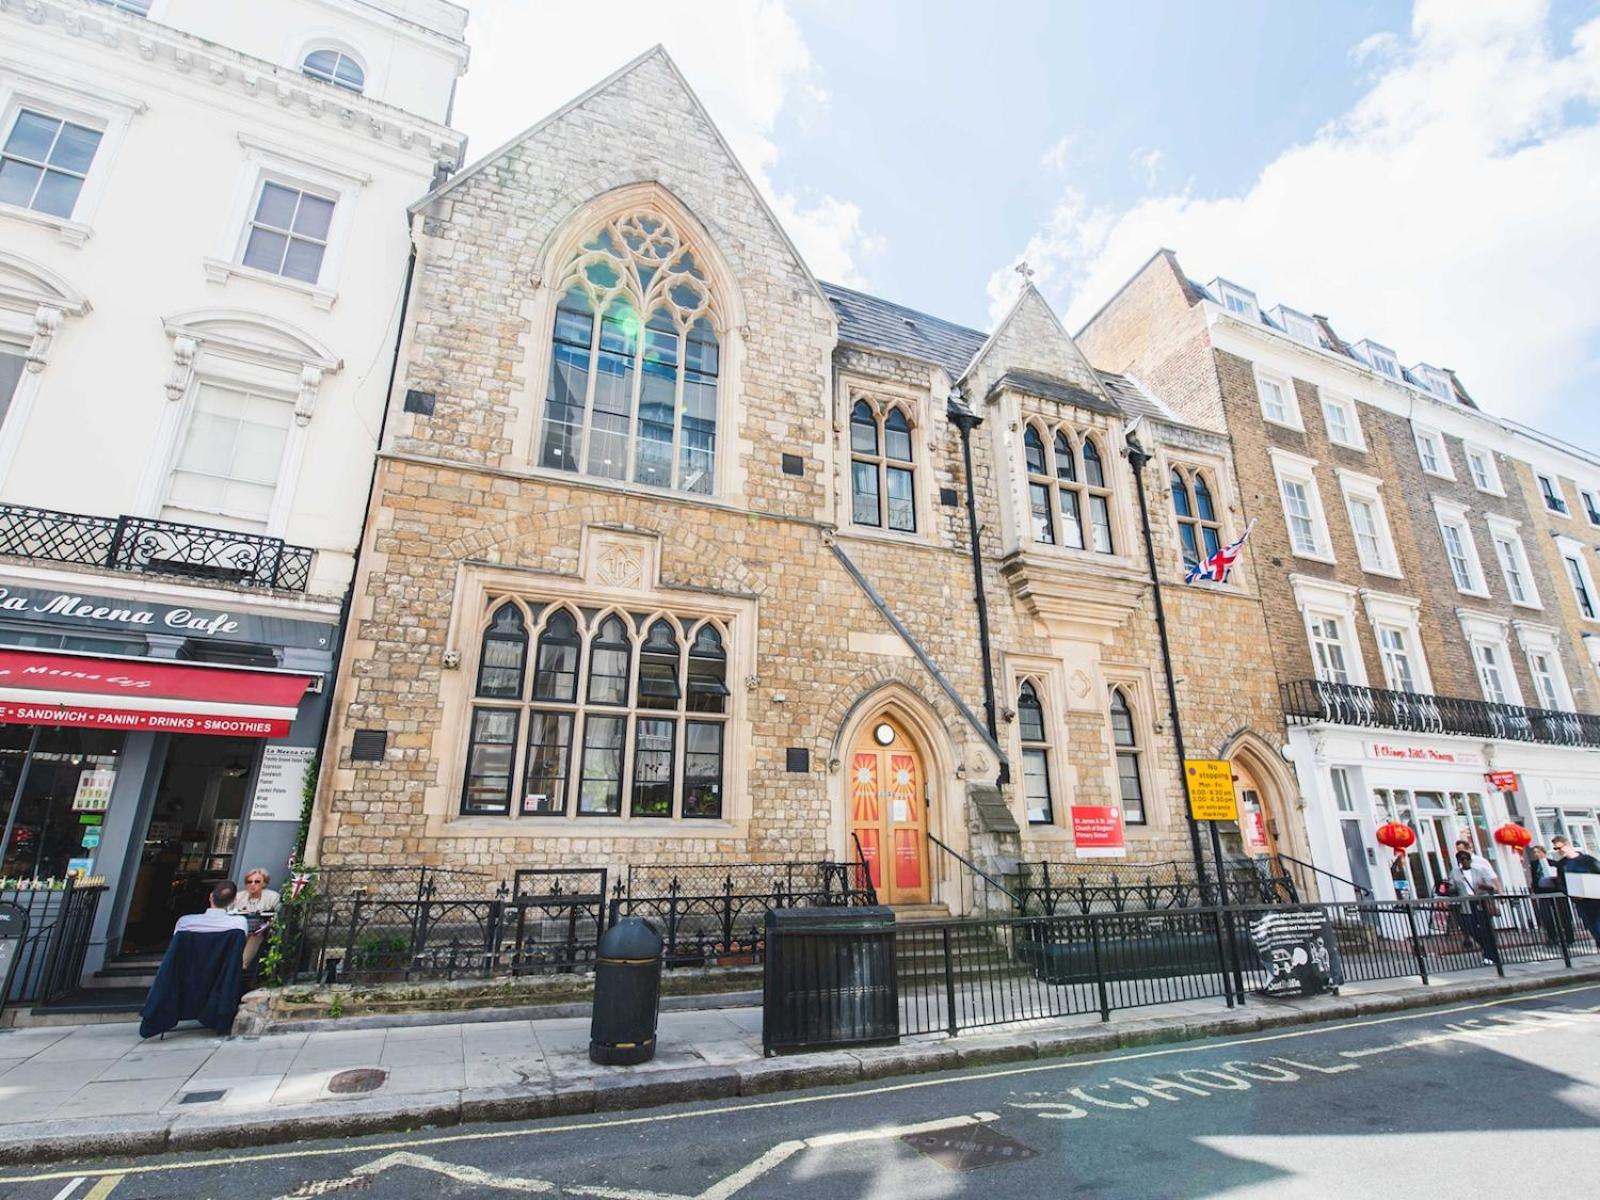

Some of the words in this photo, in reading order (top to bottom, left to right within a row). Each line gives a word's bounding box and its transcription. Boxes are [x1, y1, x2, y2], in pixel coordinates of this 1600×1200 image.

[34, 595, 155, 625] Meena
[164, 608, 240, 635] Cafe
[22, 666, 102, 680] Meena
[17, 708, 87, 722] SANDWICH
[97, 713, 139, 725] PANINI
[149, 716, 194, 728] DRINKS
[203, 720, 272, 733] SMOOTHIES
[1199, 772, 1229, 780] stopping
[1004, 1056, 1361, 1120] SCHOOL
